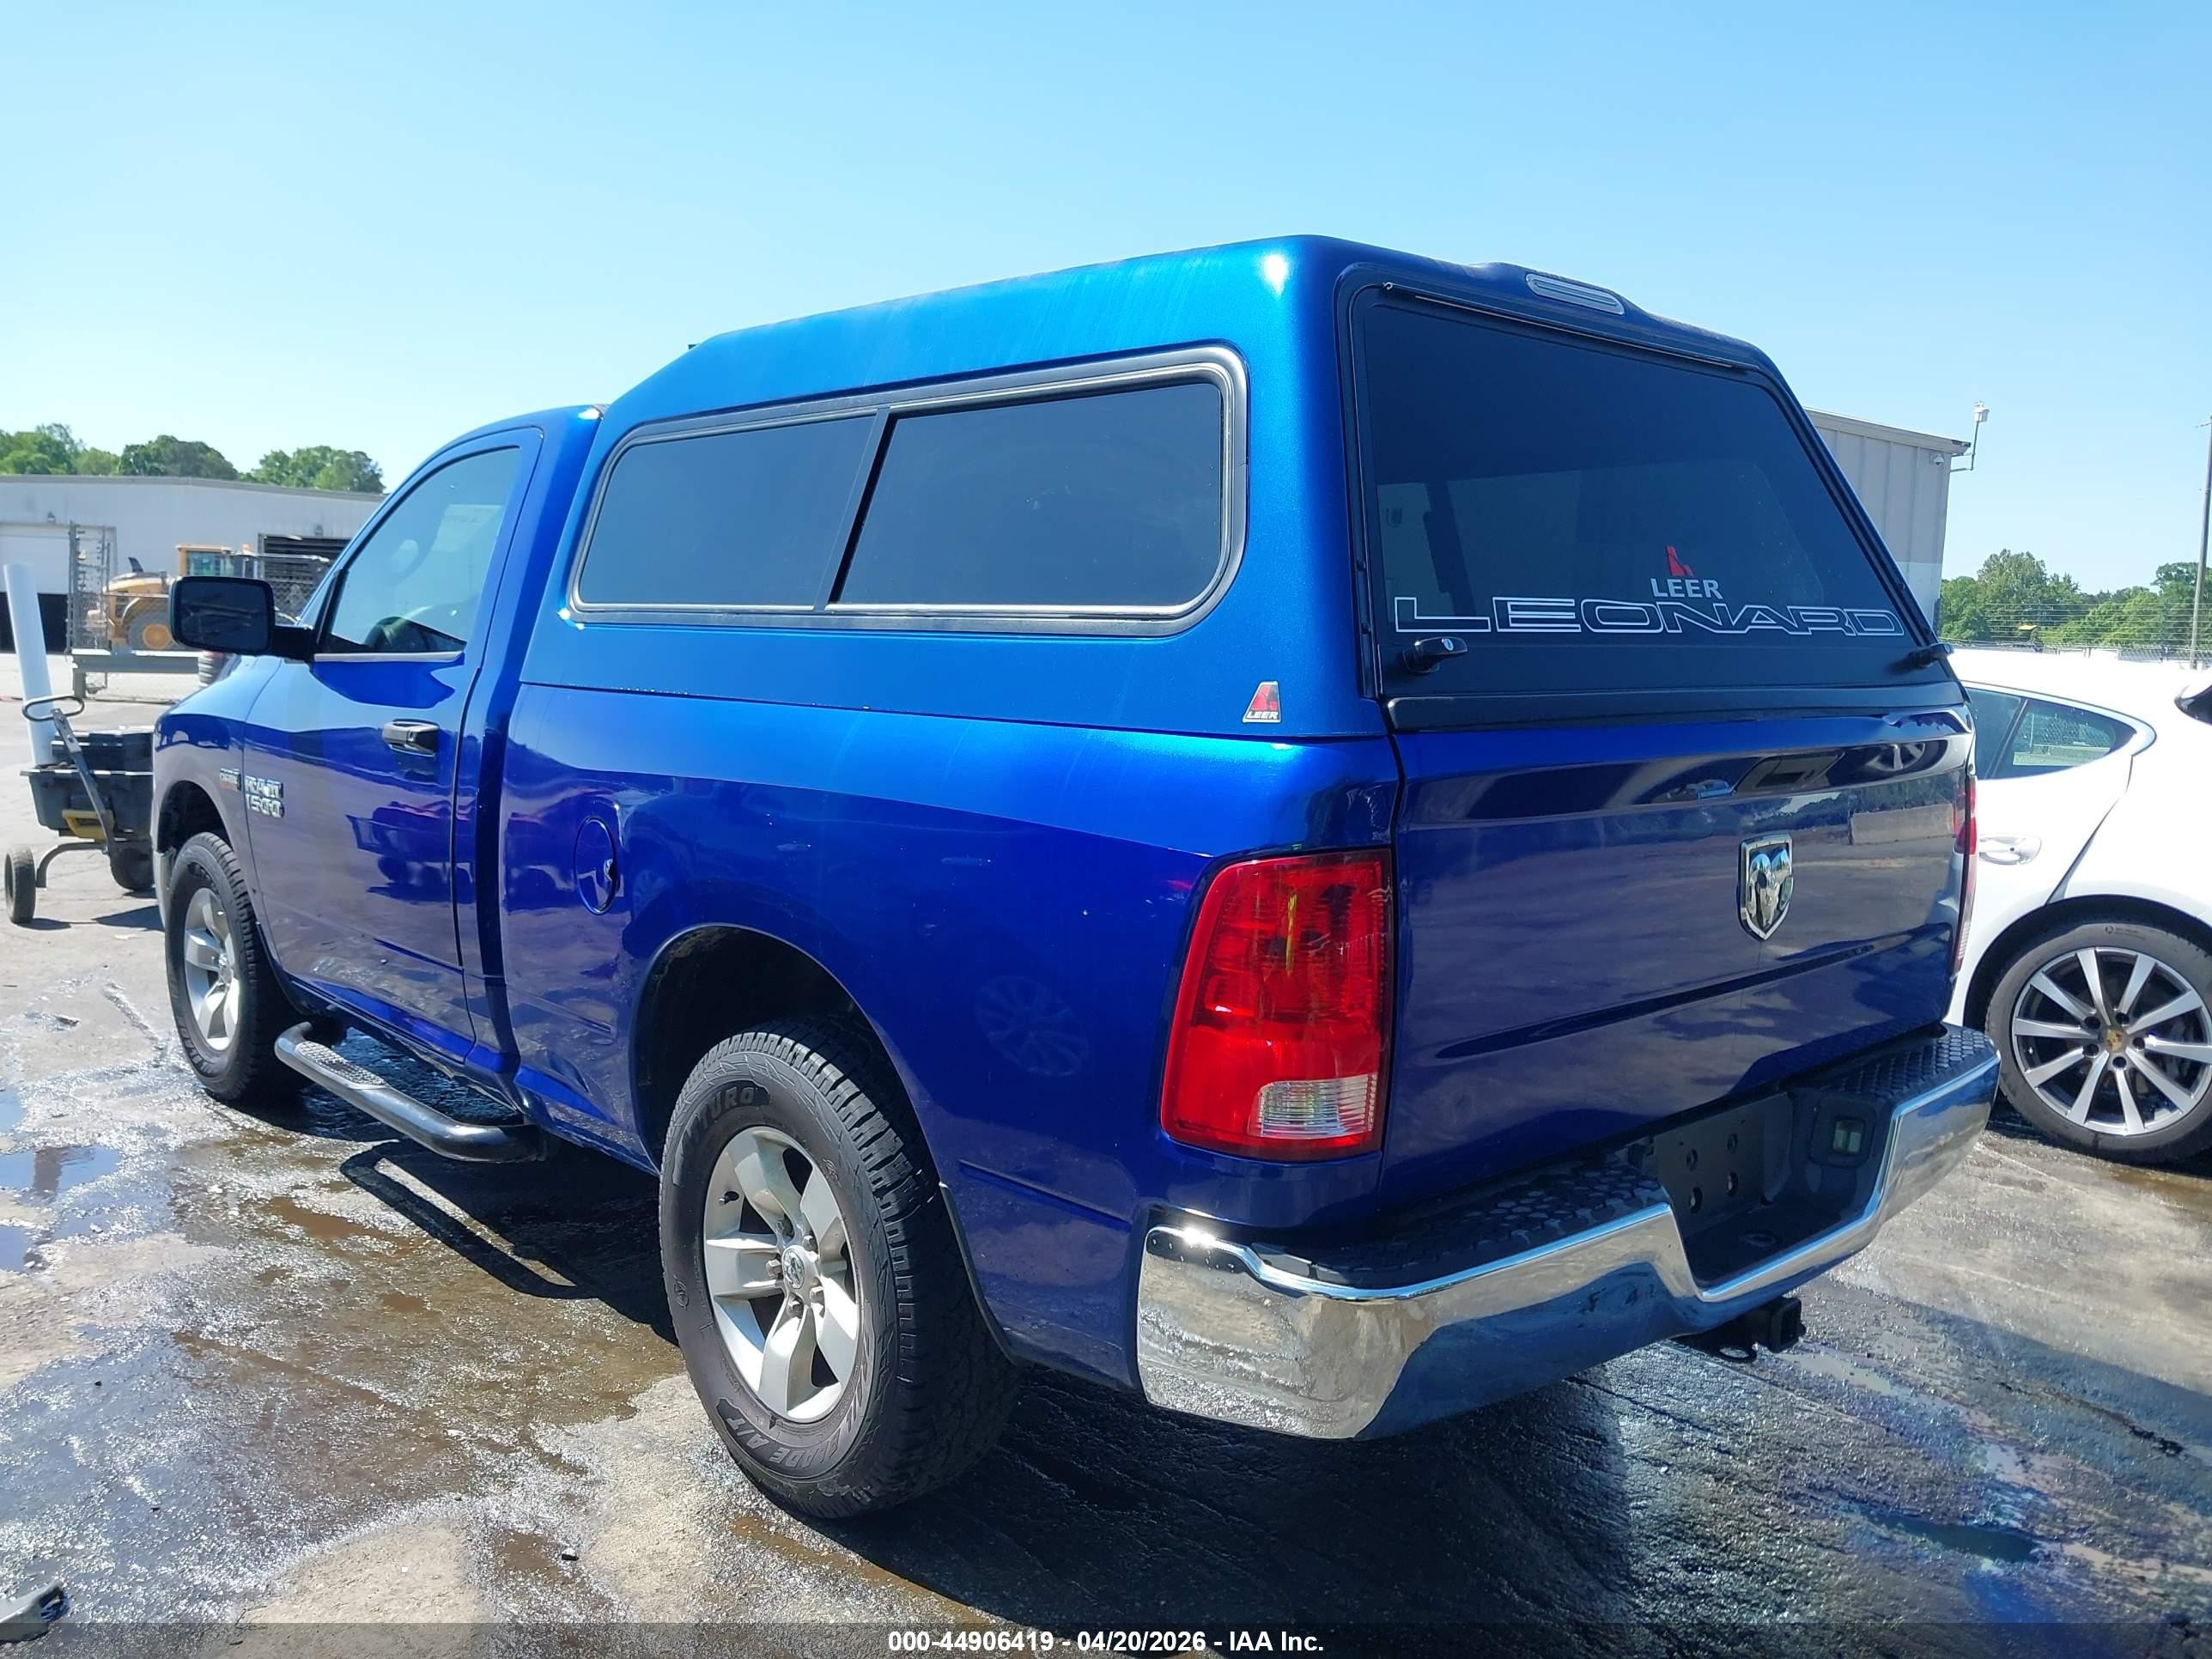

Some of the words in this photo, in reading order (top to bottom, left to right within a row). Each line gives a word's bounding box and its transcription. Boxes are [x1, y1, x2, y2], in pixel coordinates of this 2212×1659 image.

[1650, 577, 1723, 599] LEER
[1394, 594, 1905, 637] LEONARD
[1246, 711, 1279, 720] LEER
[245, 775, 283, 799] RAM
[246, 793, 284, 818] 1500
[726, 1416, 769, 1449] A/T
